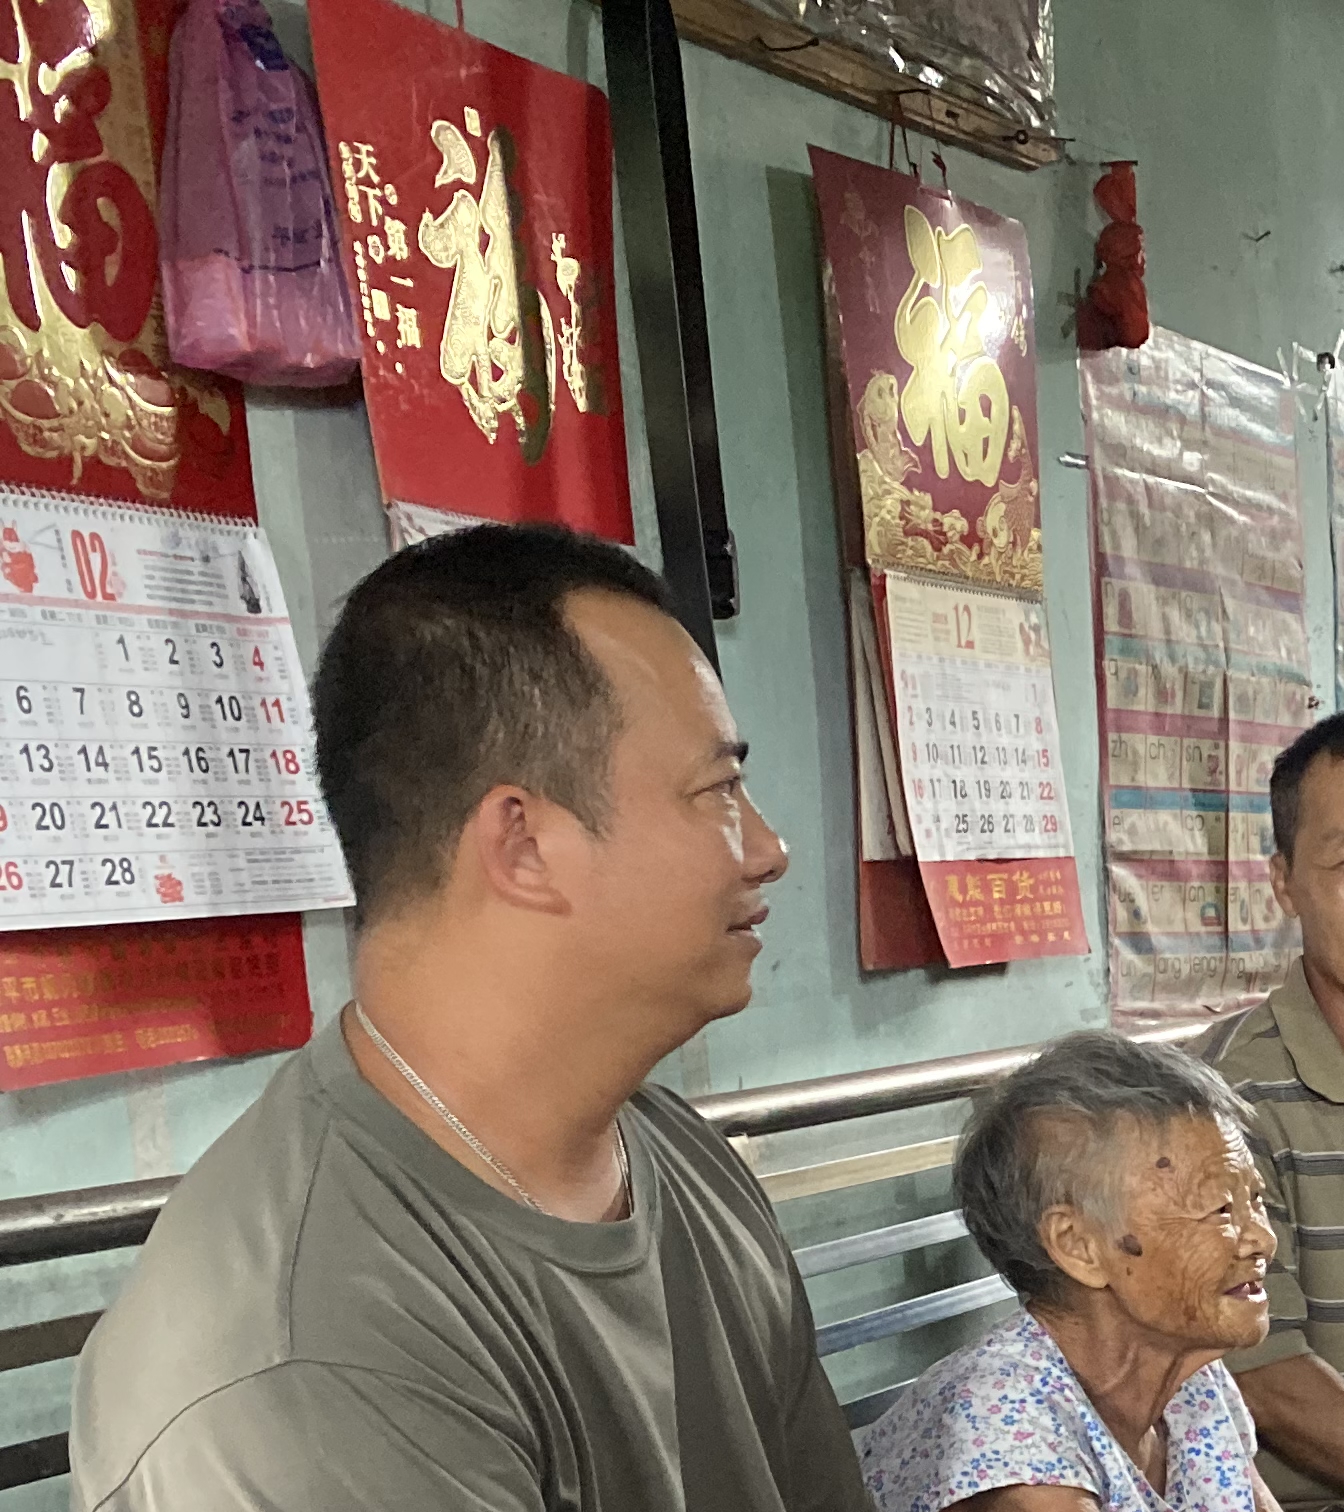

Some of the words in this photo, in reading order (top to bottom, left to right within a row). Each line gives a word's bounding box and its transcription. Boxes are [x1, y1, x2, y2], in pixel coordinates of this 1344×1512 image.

[894, 205, 1010, 488] 福
[71, 529, 117, 602] 02
[953, 603, 975, 650] 12
[116, 634, 129, 662] 1
[164, 638, 180, 665] 2
[209, 641, 225, 669] 3
[252, 646, 265, 672] 4
[15, 685, 32, 714] 6
[72, 687, 86, 715] 7
[126, 690, 144, 718] 8
[176, 692, 191, 719] 9
[214, 695, 242, 722] 10
[260, 697, 286, 724] 11
[19, 743, 55, 773] 13
[77, 743, 110, 773] 14
[131, 745, 163, 774] 15
[182, 746, 210, 775] 16
[226, 748, 252, 775] 17
[270, 749, 301, 775] 18
[925, 742, 939, 764] 10
[949, 744, 963, 765] 11
[972, 745, 988, 766] 12
[995, 746, 1008, 766] 13
[1014, 747, 1027, 767] 14
[1036, 748, 1050, 768] 15
[912, 778, 925, 799] 16
[929, 778, 943, 799] 17
[951, 779, 968, 800] 18
[975, 780, 991, 800] 19
[999, 780, 1012, 800] 20
[1018, 781, 1031, 801] 21
[1038, 781, 1055, 801] 22
[32, 801, 66, 831] 20
[90, 801, 123, 830] 21
[142, 801, 176, 829] 22
[192, 801, 222, 828] 23
[237, 801, 266, 827] 24
[280, 800, 315, 826] 25
[954, 813, 970, 834] 25
[979, 814, 995, 834] 26
[1002, 814, 1017, 834] 27
[1022, 814, 1036, 834] 28
[1042, 814, 1058, 834] 29
[45, 860, 75, 888] 27
[101, 857, 136, 886] 28
